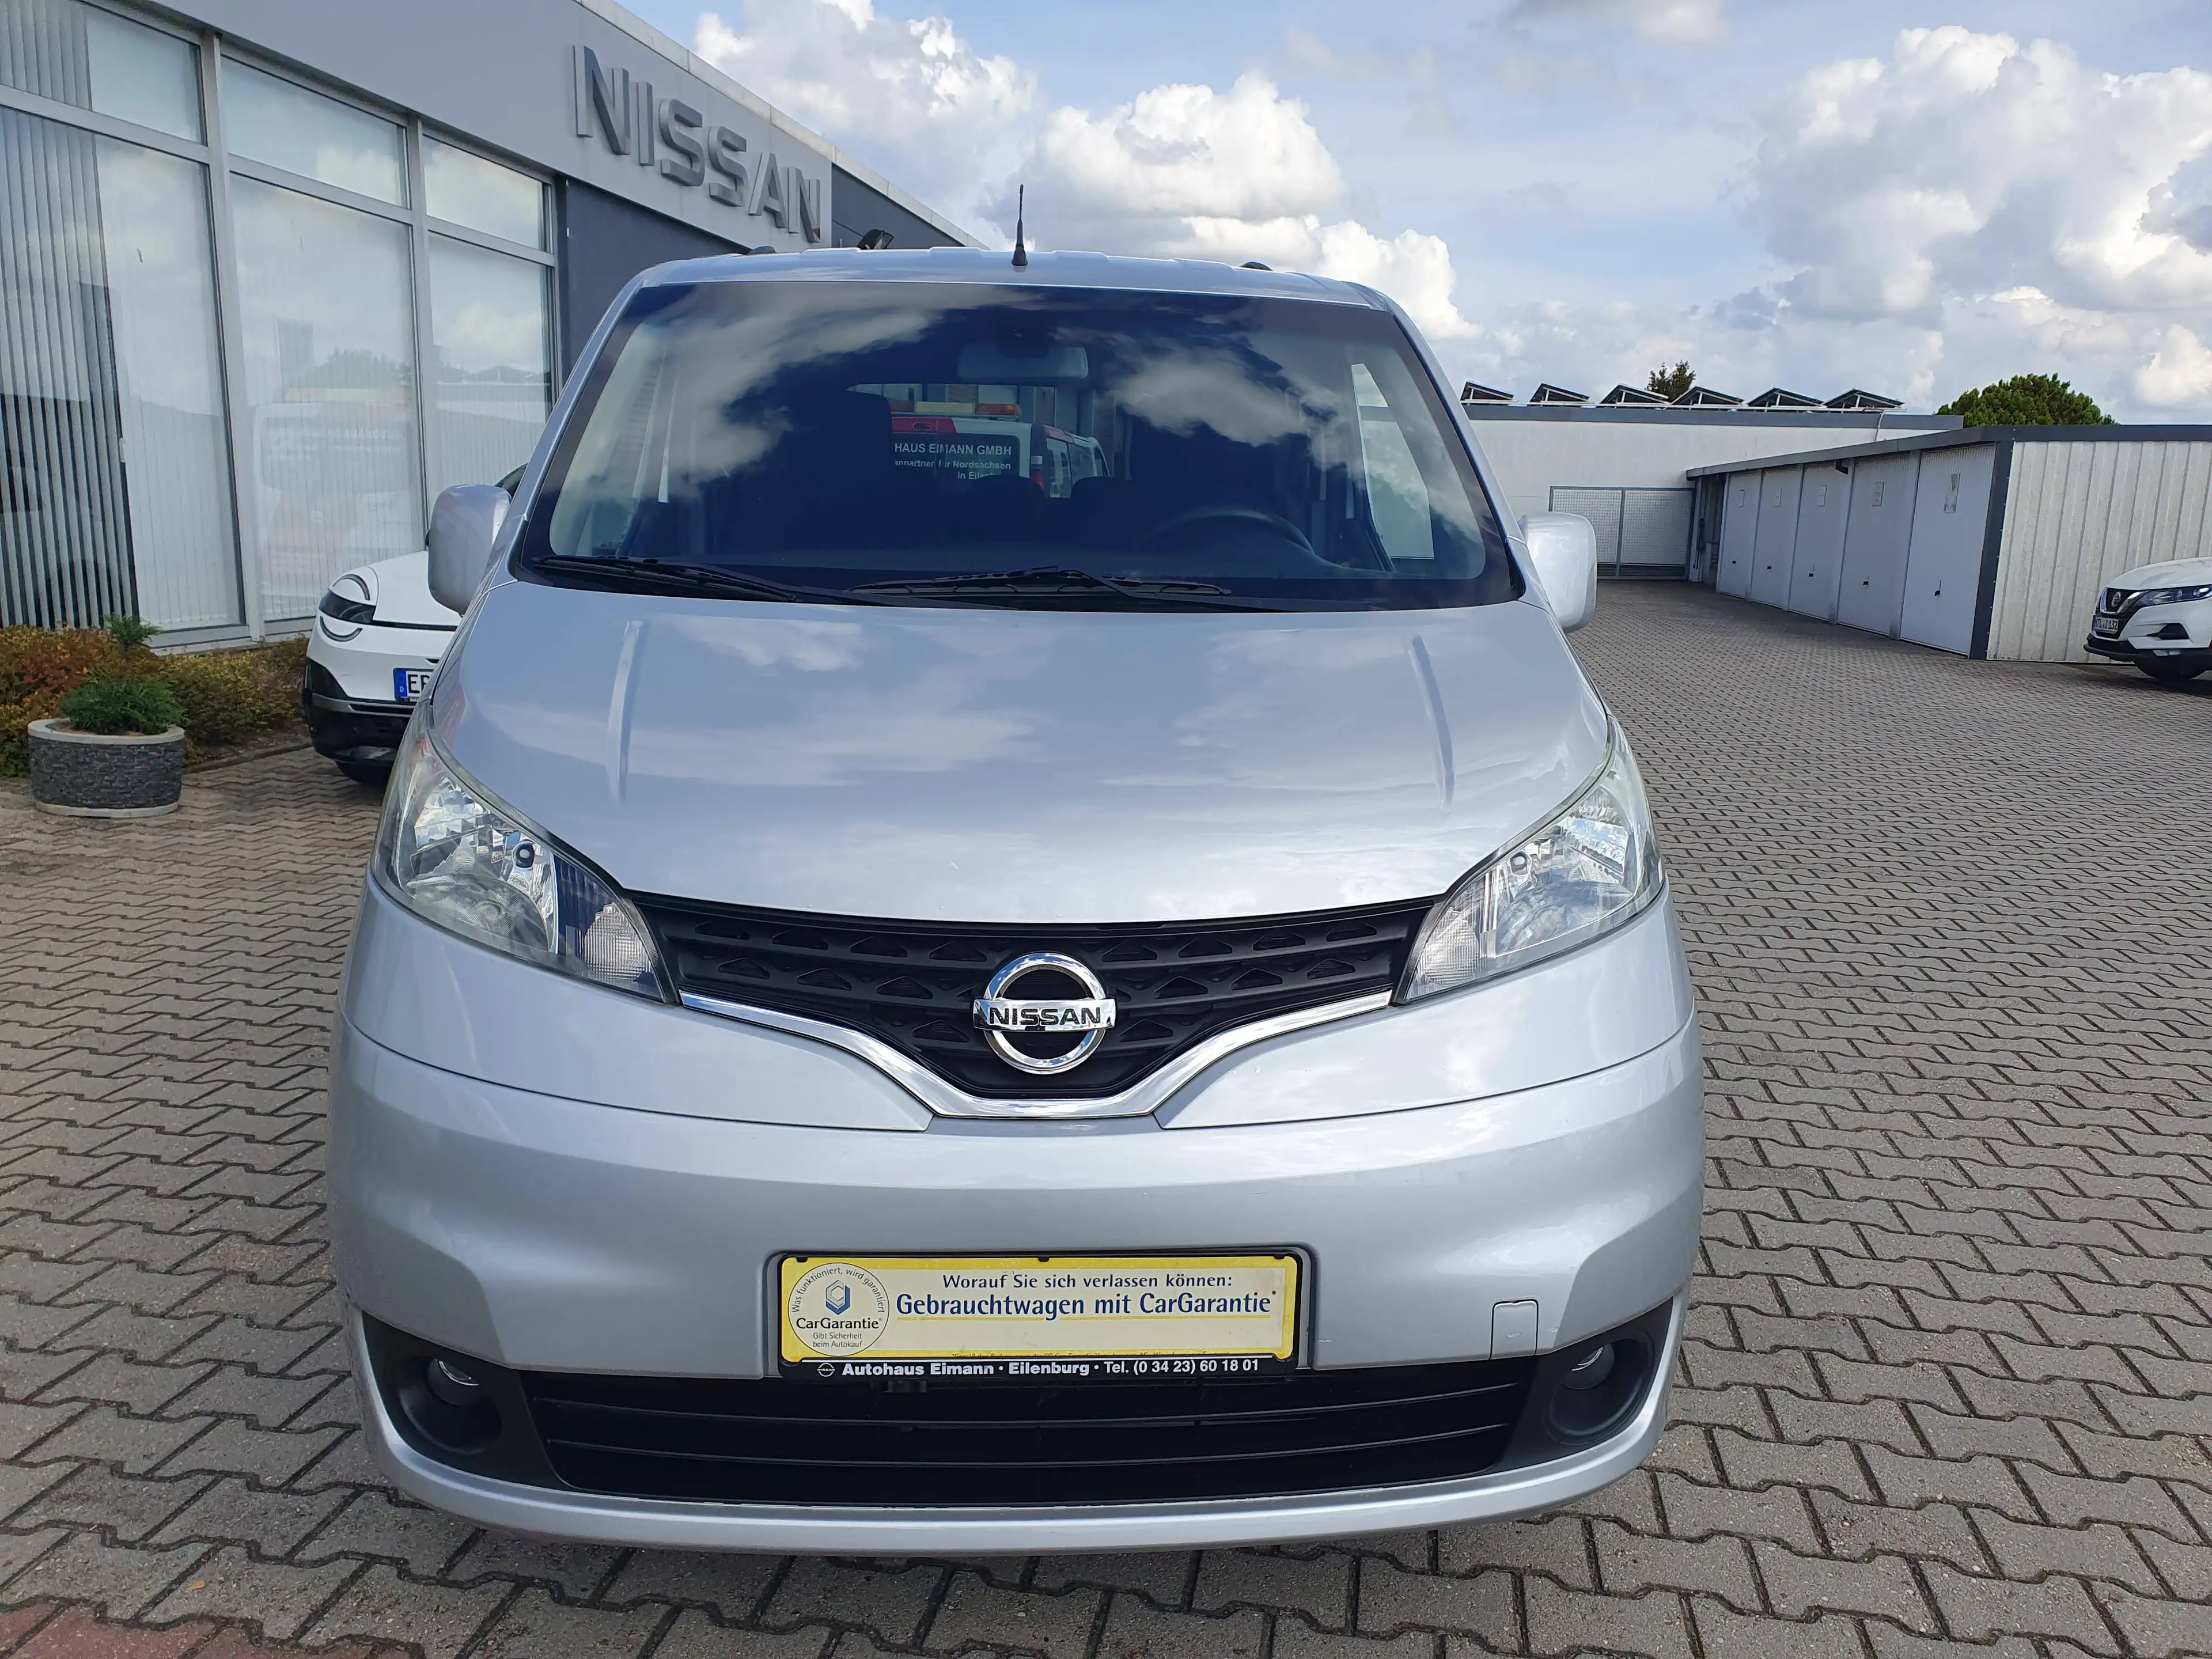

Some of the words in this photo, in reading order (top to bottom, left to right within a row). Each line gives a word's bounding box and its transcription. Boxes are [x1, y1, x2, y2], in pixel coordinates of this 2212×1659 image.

[574, 44, 820, 243] NISSAN
[929, 444, 974, 454] EIMANN
[977, 445, 1012, 456] GMBH
[938, 460, 950, 468] fr
[953, 460, 1011, 469] Nordsachsen
[989, 1007, 1100, 1025] NISSAN
[943, 1274, 1008, 1288] Worauf
[1013, 1274, 1038, 1288] Sie
[1044, 1274, 1076, 1288] sich
[1083, 1274, 1158, 1287] verlassen
[1166, 1274, 1233, 1287] können:
[791, 1297, 802, 1313] Was
[797, 1267, 843, 1294] funktioniert,
[846, 1268, 865, 1279] wird
[862, 1278, 885, 1313] garantiert
[896, 1293, 1084, 1321] Gebrauchtwagen
[1094, 1293, 1132, 1314] mit
[842, 1363, 925, 1376] Autohaus
[930, 1363, 994, 1375] Eimann
[1009, 1362, 1089, 1376] Eilenburg
[1104, 1361, 1129, 1373] Tel.
[1134, 1359, 1147, 1375] (0
[1152, 1360, 1169, 1373] 34
[1173, 1359, 1196, 1375] 23)
[1200, 1359, 1217, 1372] 60
[1222, 1359, 1238, 1372] 18
[1243, 1359, 1258, 1371] 01
